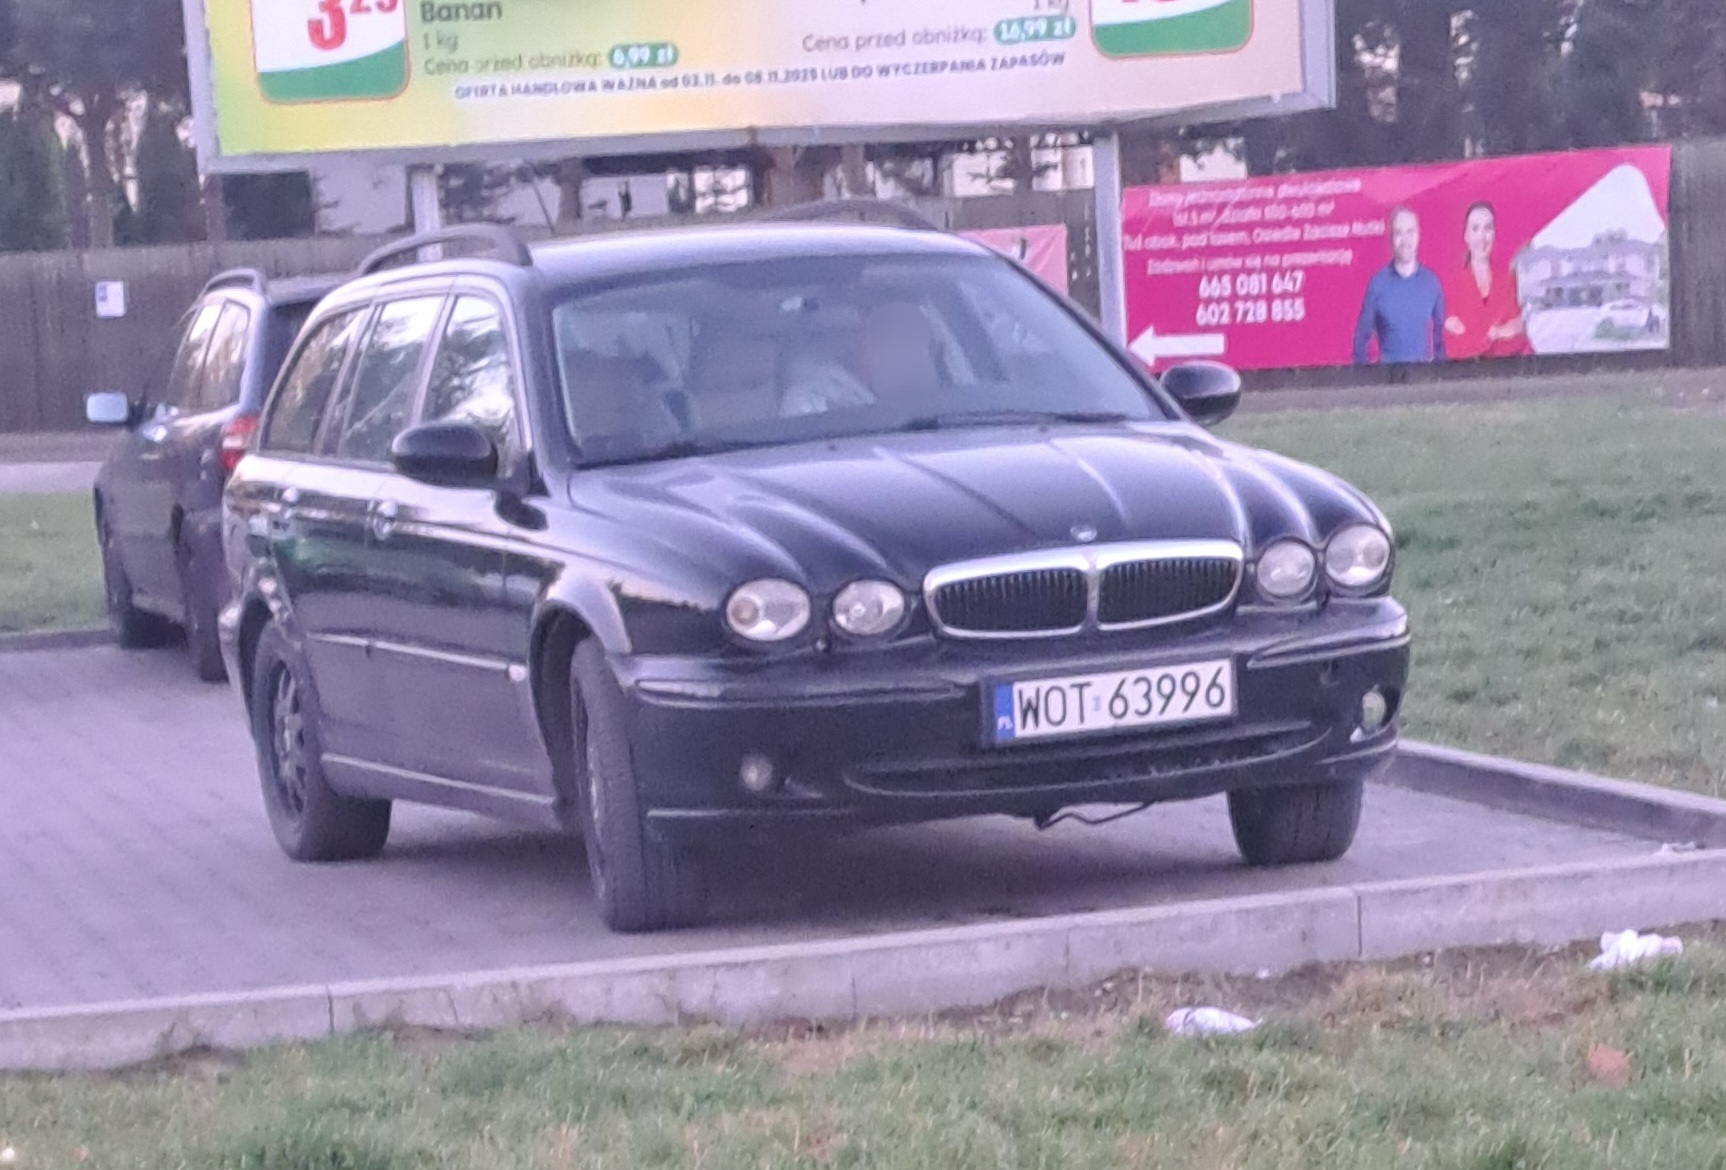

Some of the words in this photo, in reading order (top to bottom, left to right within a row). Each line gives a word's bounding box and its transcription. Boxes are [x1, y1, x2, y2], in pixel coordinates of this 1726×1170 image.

[421, 1, 503, 23] Banan
[423, 32, 430, 50] 1
[436, 30, 459, 54] kg
[803, 33, 849, 52] Cena
[855, 29, 906, 52] przed
[1054, 15, 1071, 37] zł
[424, 58, 469, 76] Cena
[455, 83, 507, 100] OFERTA
[511, 77, 598, 96] HANDLOWA
[660, 75, 679, 89] od
[722, 72, 741, 86] do
[821, 66, 848, 80] LUB
[851, 65, 873, 78] DO
[877, 57, 986, 77] WYCZERPANIA
[991, 50, 1065, 71] ZAPASÓW
[1199, 274, 1231, 298] 665
[1236, 272, 1267, 296] 081
[1271, 269, 1305, 294] 647
[1196, 301, 1230, 326] 602
[1233, 300, 1267, 323] 728
[1271, 297, 1306, 322] 855
[1018, 681, 1092, 730] WOT
[1108, 667, 1226, 719] 63996
